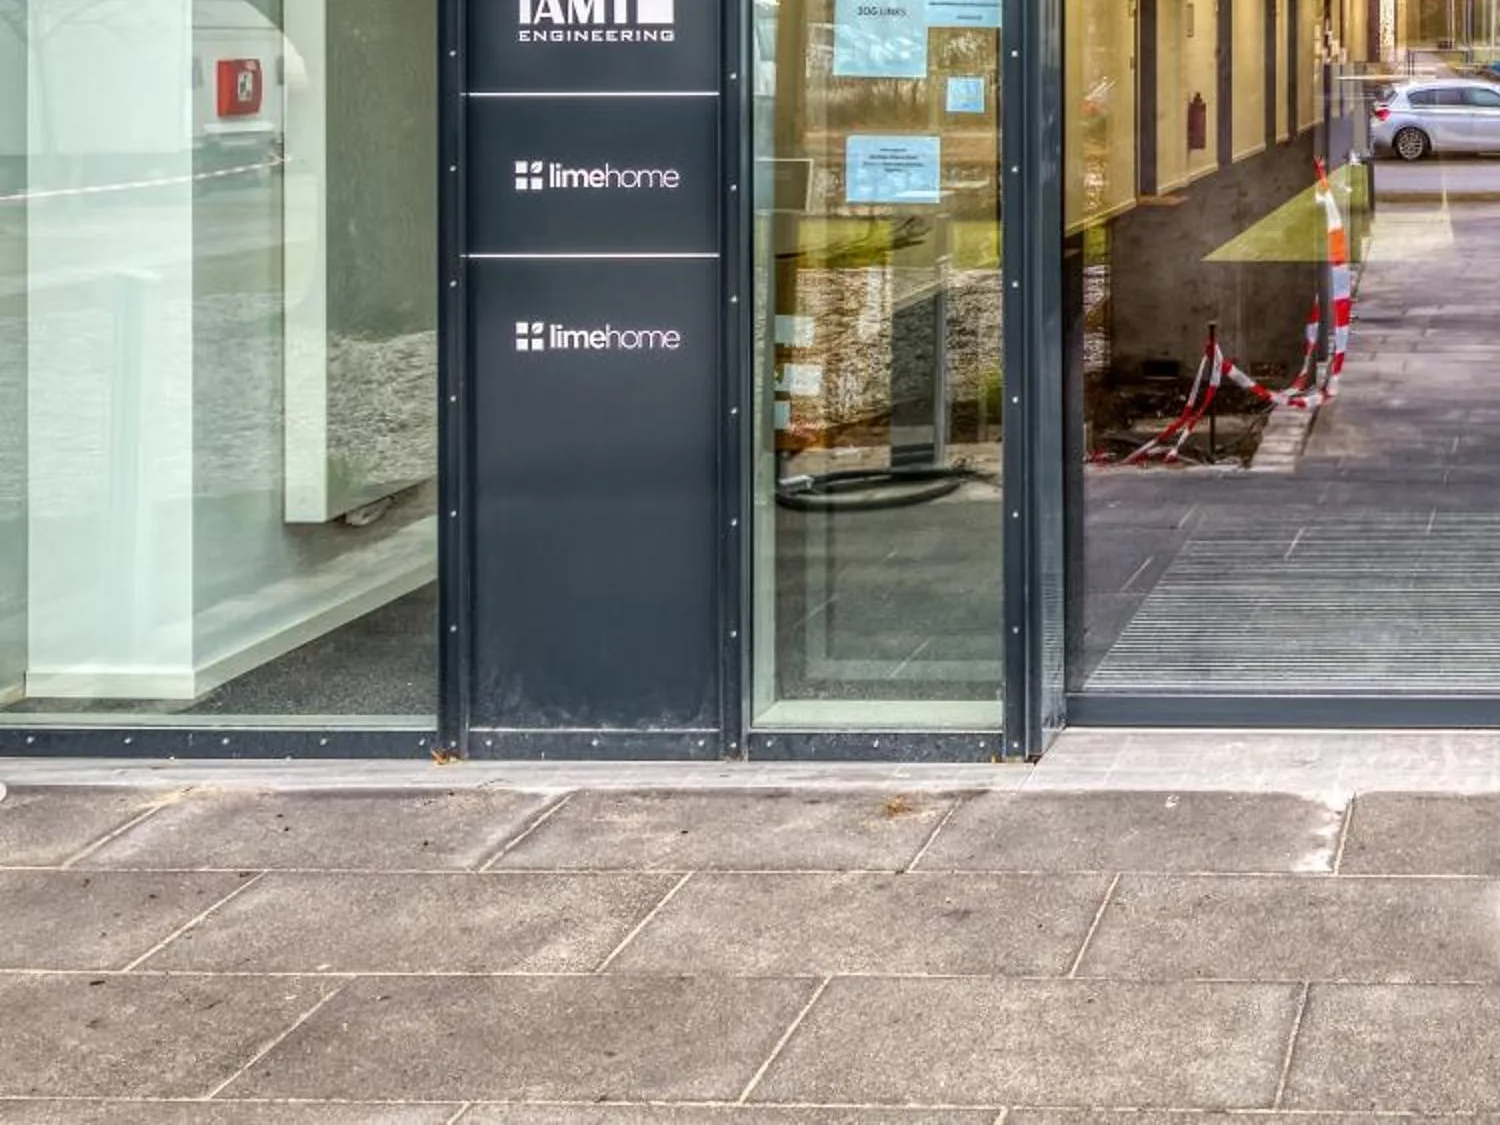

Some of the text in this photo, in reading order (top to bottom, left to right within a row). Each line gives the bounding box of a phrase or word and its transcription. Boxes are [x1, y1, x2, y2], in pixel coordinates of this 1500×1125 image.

[518, 29, 675, 42] ENGINEERING
[549, 162, 680, 189] limehome
[549, 323, 681, 349] limehome
